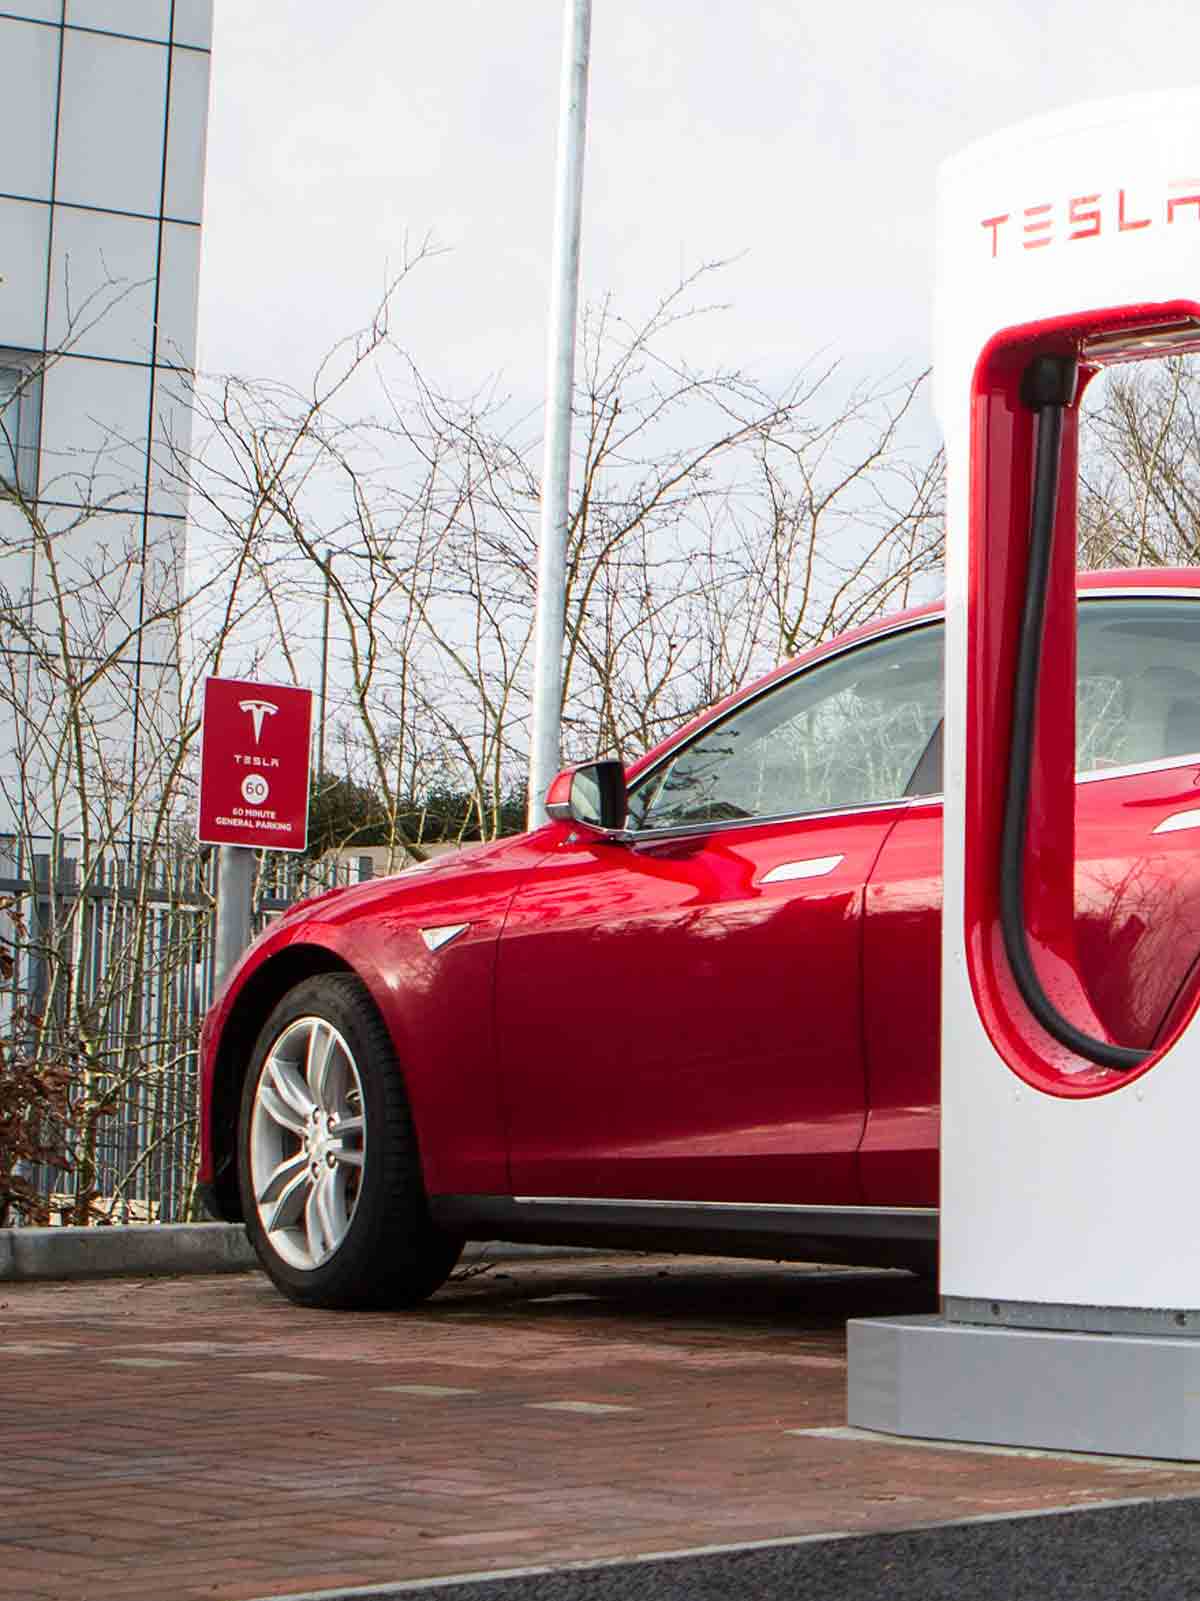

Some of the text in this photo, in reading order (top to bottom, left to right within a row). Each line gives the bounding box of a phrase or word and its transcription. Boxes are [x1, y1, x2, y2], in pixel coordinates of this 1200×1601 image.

[233, 754, 280, 767] TESLA
[246, 782, 265, 796] 60
[232, 807, 276, 820] 60 MINUTE
[215, 816, 292, 832] GENERAL PARKING
